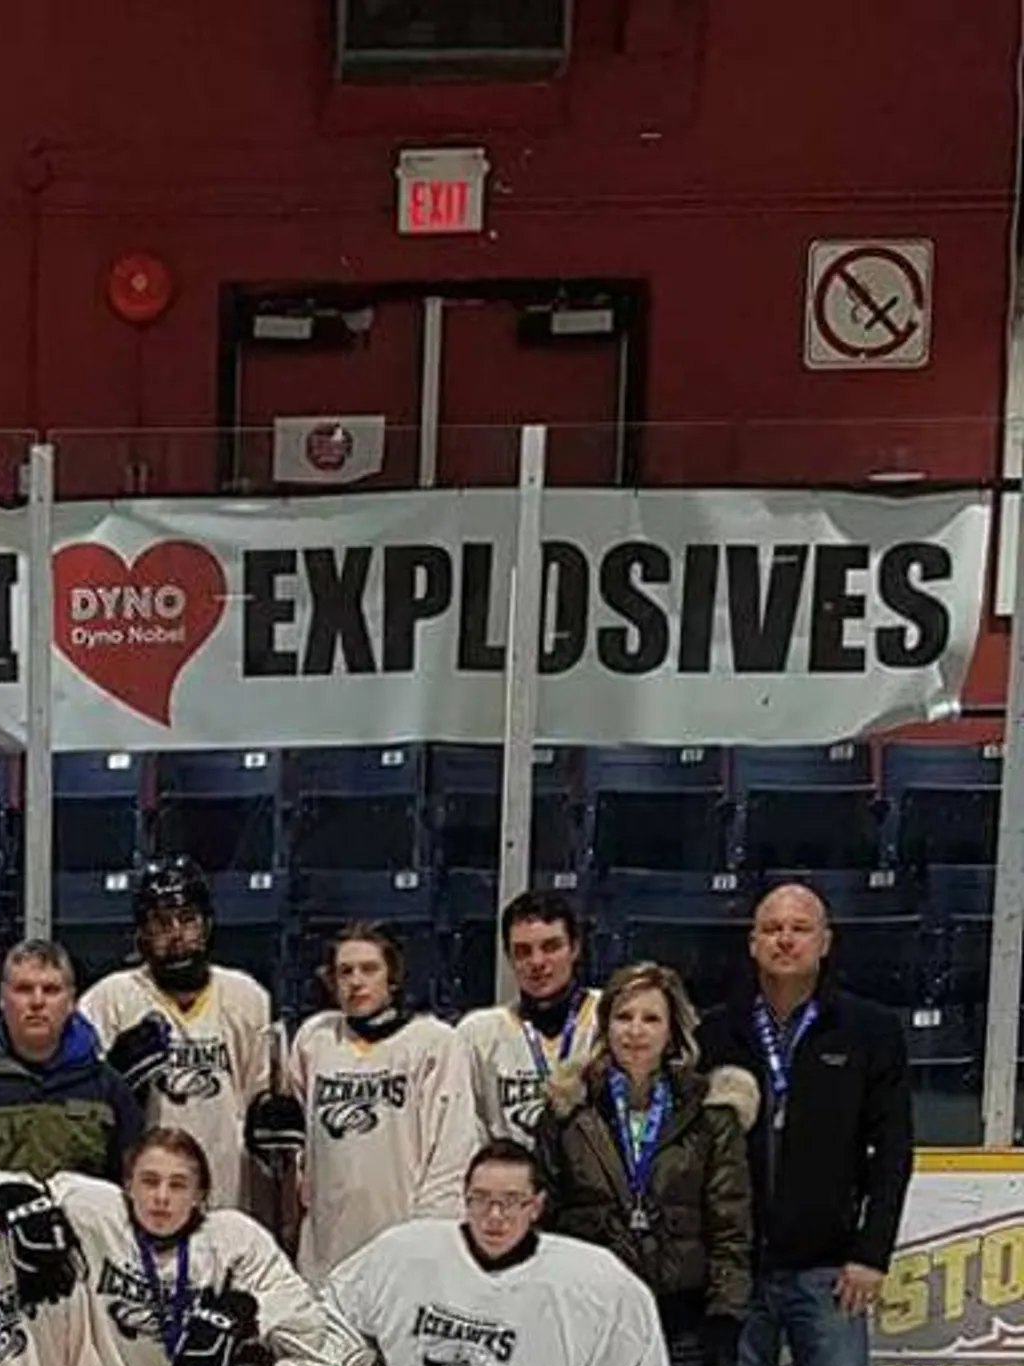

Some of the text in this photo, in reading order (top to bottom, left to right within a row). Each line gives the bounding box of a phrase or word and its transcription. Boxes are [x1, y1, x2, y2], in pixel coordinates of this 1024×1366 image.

[410, 180, 468, 228] EXIT
[71, 586, 187, 621] DYNO
[243, 541, 954, 680] EXPLOSIVES
[71, 625, 186, 648] Dyno Nobel
[412, 1305, 517, 1364] ICEHAWKS
